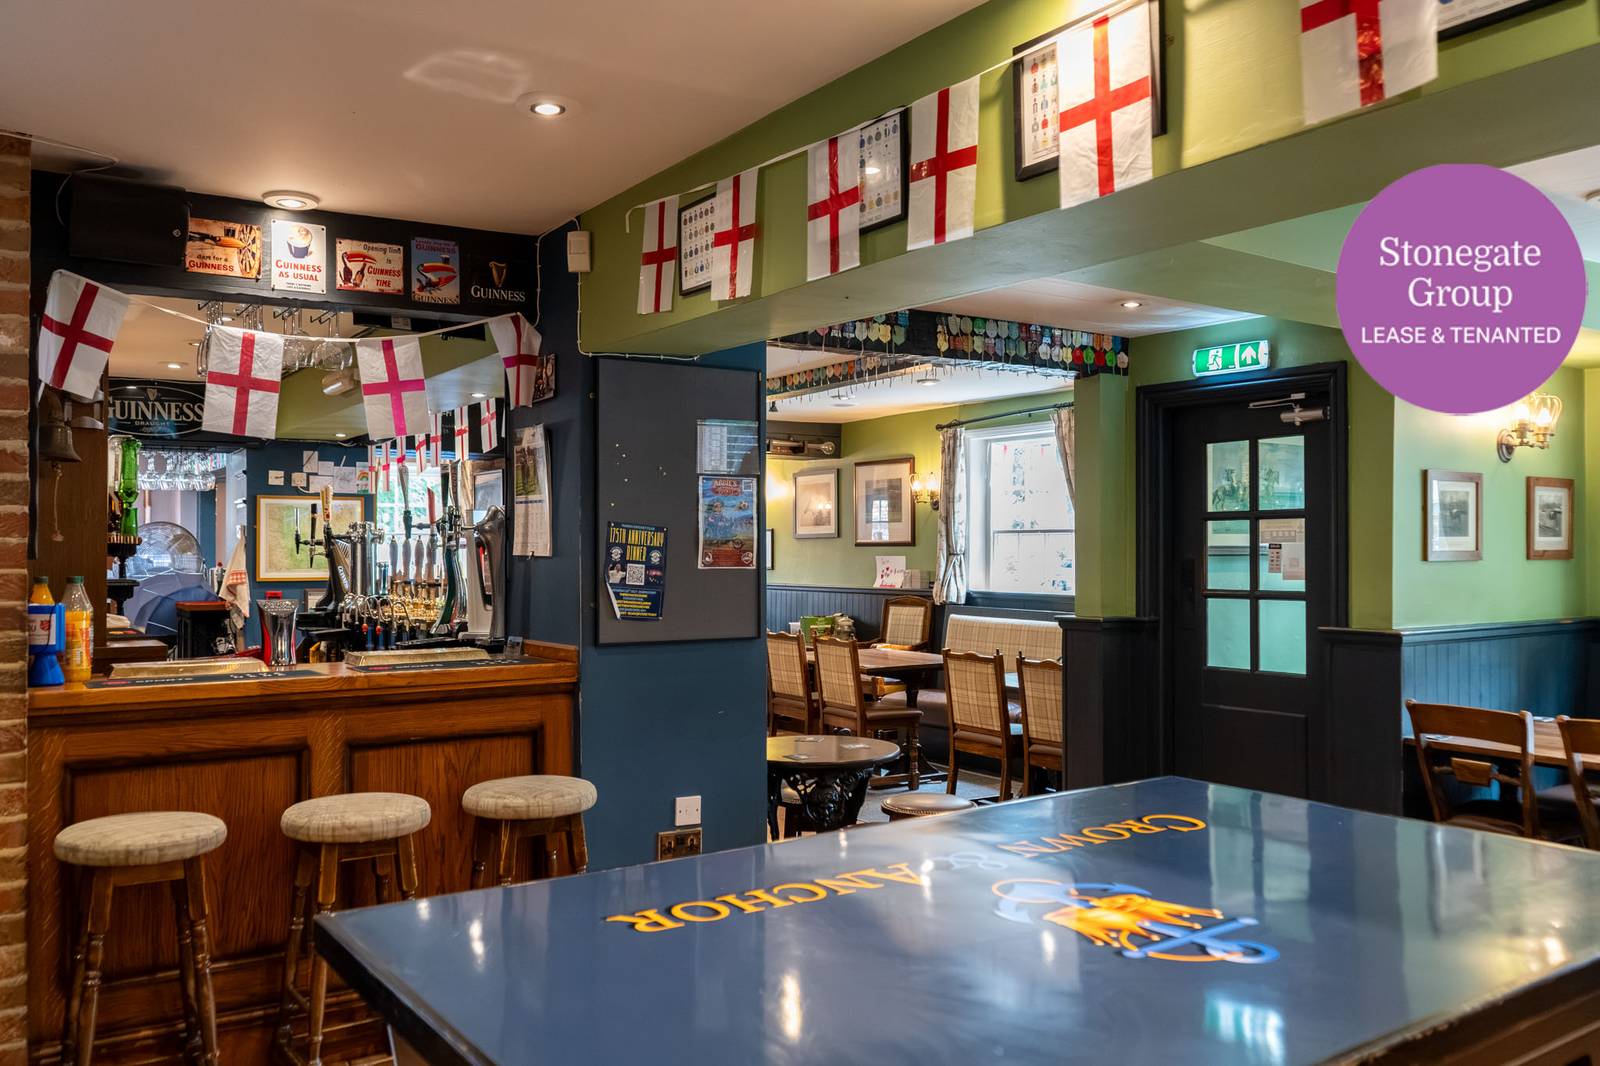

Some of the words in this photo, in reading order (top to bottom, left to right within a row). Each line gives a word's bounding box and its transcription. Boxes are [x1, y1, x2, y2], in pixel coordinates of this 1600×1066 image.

[363, 243, 387, 255] Opening
[188, 259, 235, 272] GUINNESS
[275, 259, 322, 273] GUINNESS
[367, 265, 401, 278] GUINNESS
[292, 272, 320, 281] USUAL
[375, 279, 392, 287] TIME
[414, 294, 458, 304] GUINNESS
[470, 285, 526, 302] GUINNESS
[997, 814, 1207, 858] CROWN
[606, 863, 924, 932] ANCHOR
